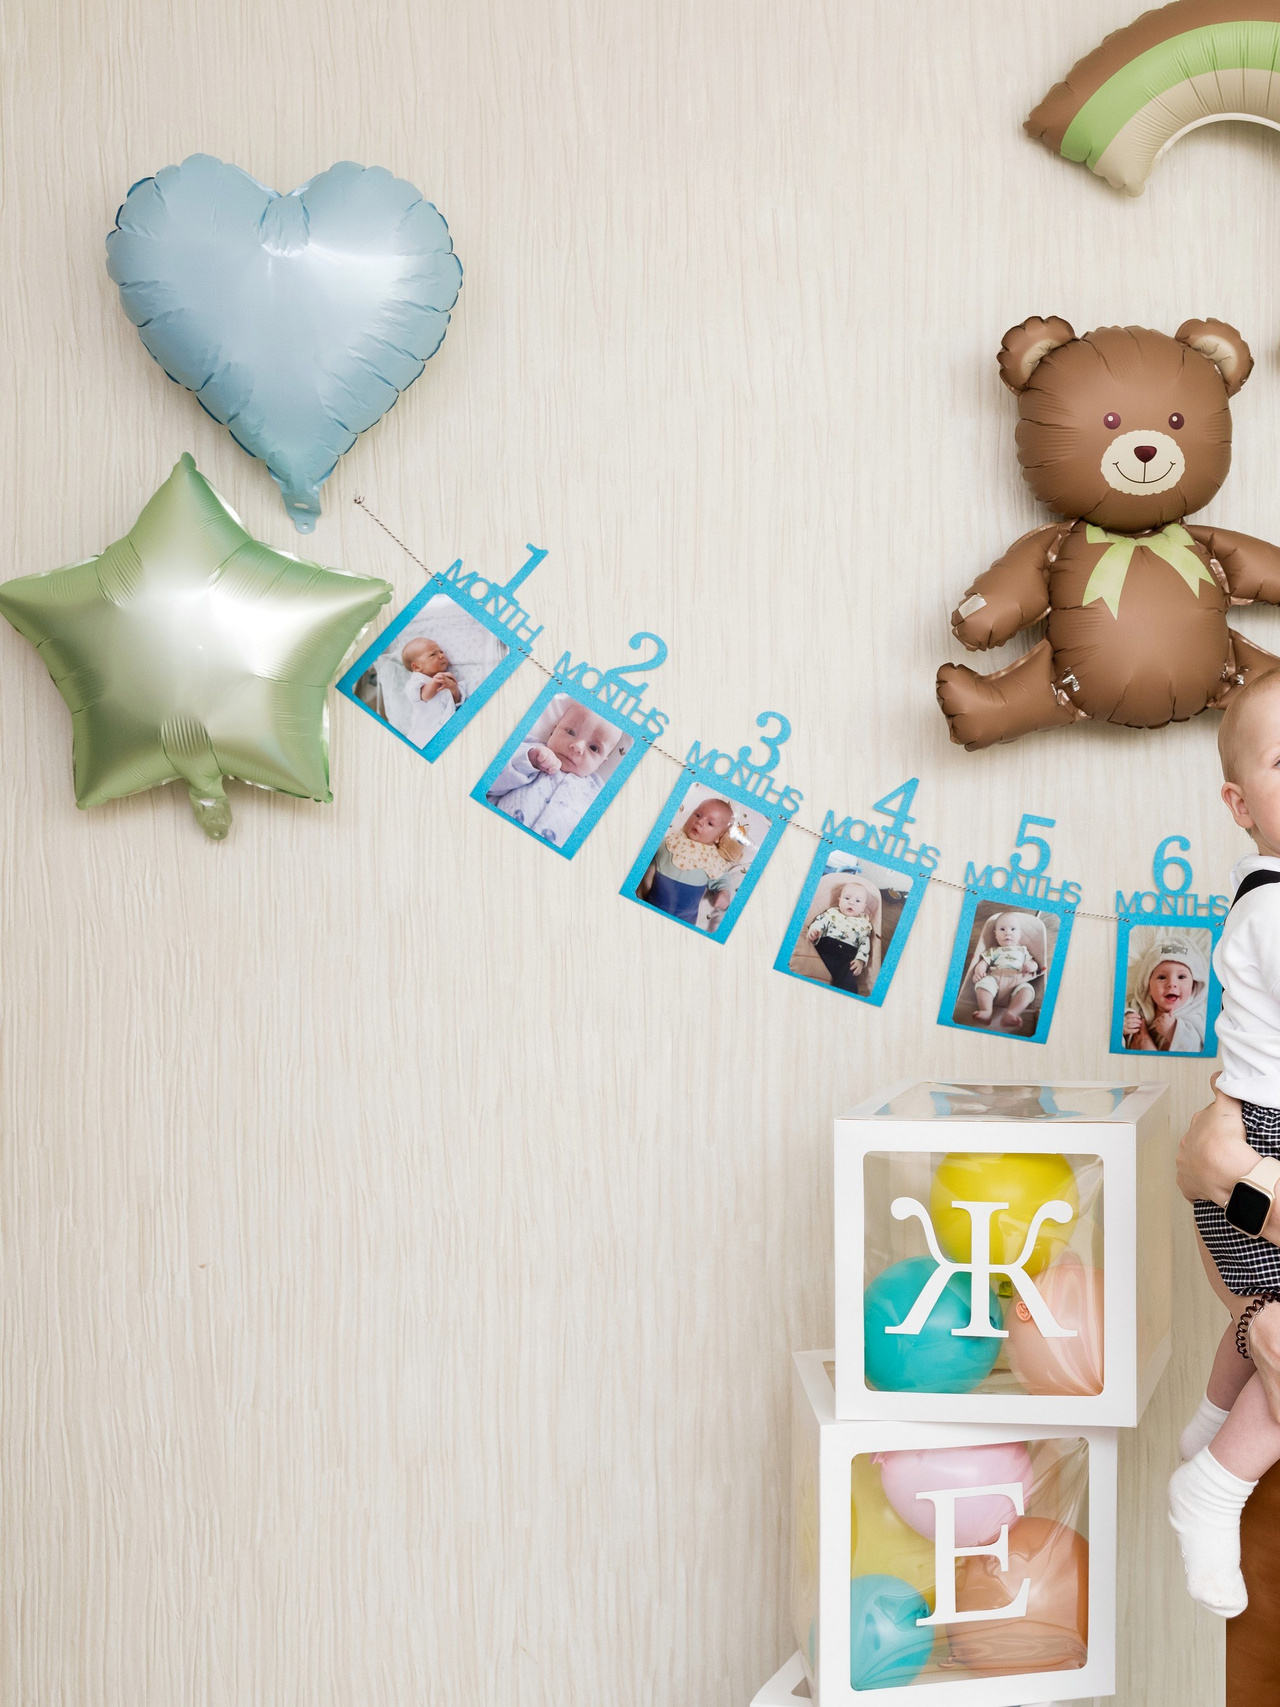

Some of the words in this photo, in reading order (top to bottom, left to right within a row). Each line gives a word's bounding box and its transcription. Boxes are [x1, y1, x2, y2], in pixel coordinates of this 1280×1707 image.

[501, 543, 549, 599] 1
[442, 558, 545, 647] MONTH
[606, 632, 668, 688] 2
[553, 650, 669, 737] MONTHS
[739, 711, 792, 774] 3
[686, 740, 804, 813] MONTHS
[873, 777, 919, 834] 4
[822, 809, 941, 870] MONTHS
[1010, 814, 1056, 876] 5
[1153, 835, 1193, 896] 6
[965, 861, 1083, 905] MONTHS
[1116, 890, 1230, 917] MONTHS
[885, 1196, 1078, 1338] Ж
[916, 1482, 1032, 1626] Е
